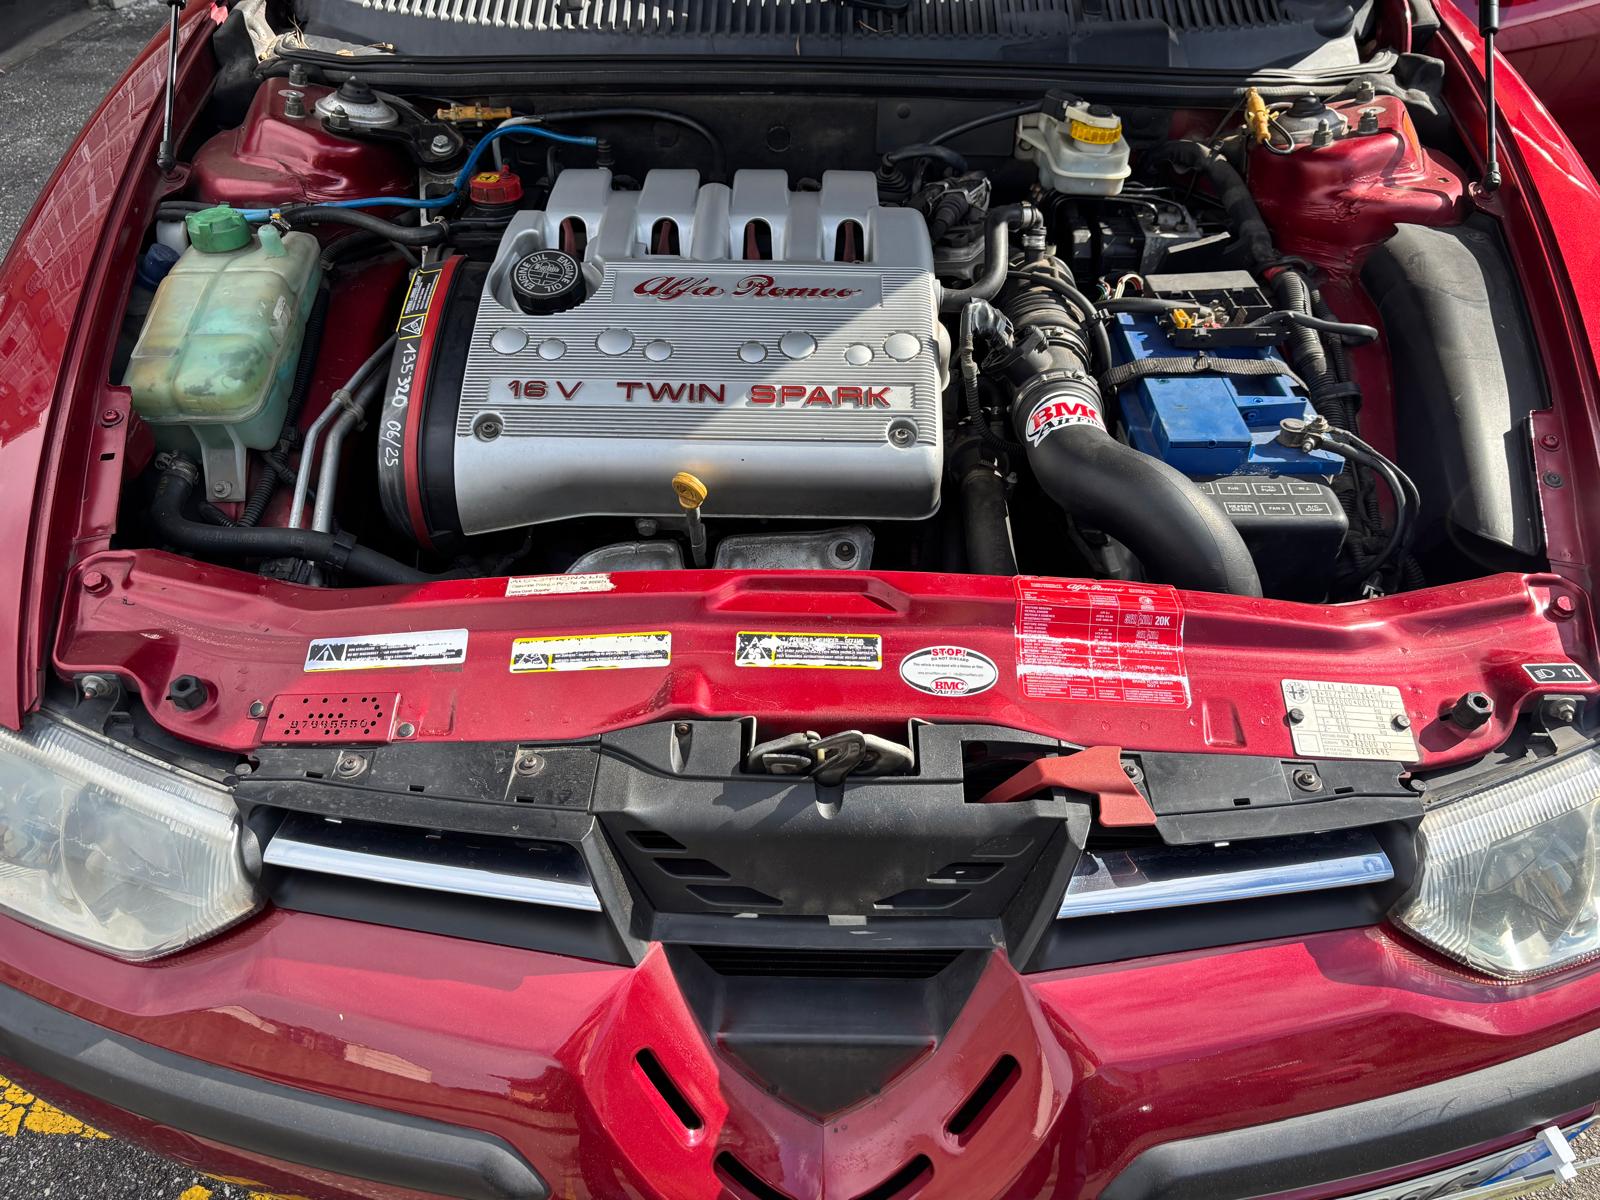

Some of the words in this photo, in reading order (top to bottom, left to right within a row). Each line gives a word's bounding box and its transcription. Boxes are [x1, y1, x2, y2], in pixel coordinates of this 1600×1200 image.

[518, 262, 535, 290] ENGINE
[530, 254, 548, 263] OIL
[556, 256, 574, 284] ENGINE
[544, 283, 562, 292] OIL
[632, 275, 726, 301] Alfa
[731, 274, 864, 300] Romeo
[508, 380, 547, 400] 16
[556, 380, 584, 401] V
[616, 381, 725, 404] TWIN
[750, 384, 891, 408] SPARK
[1154, 616, 1170, 626] 20K
[932, 648, 966, 657] STOP!
[935, 681, 964, 690] BMC
